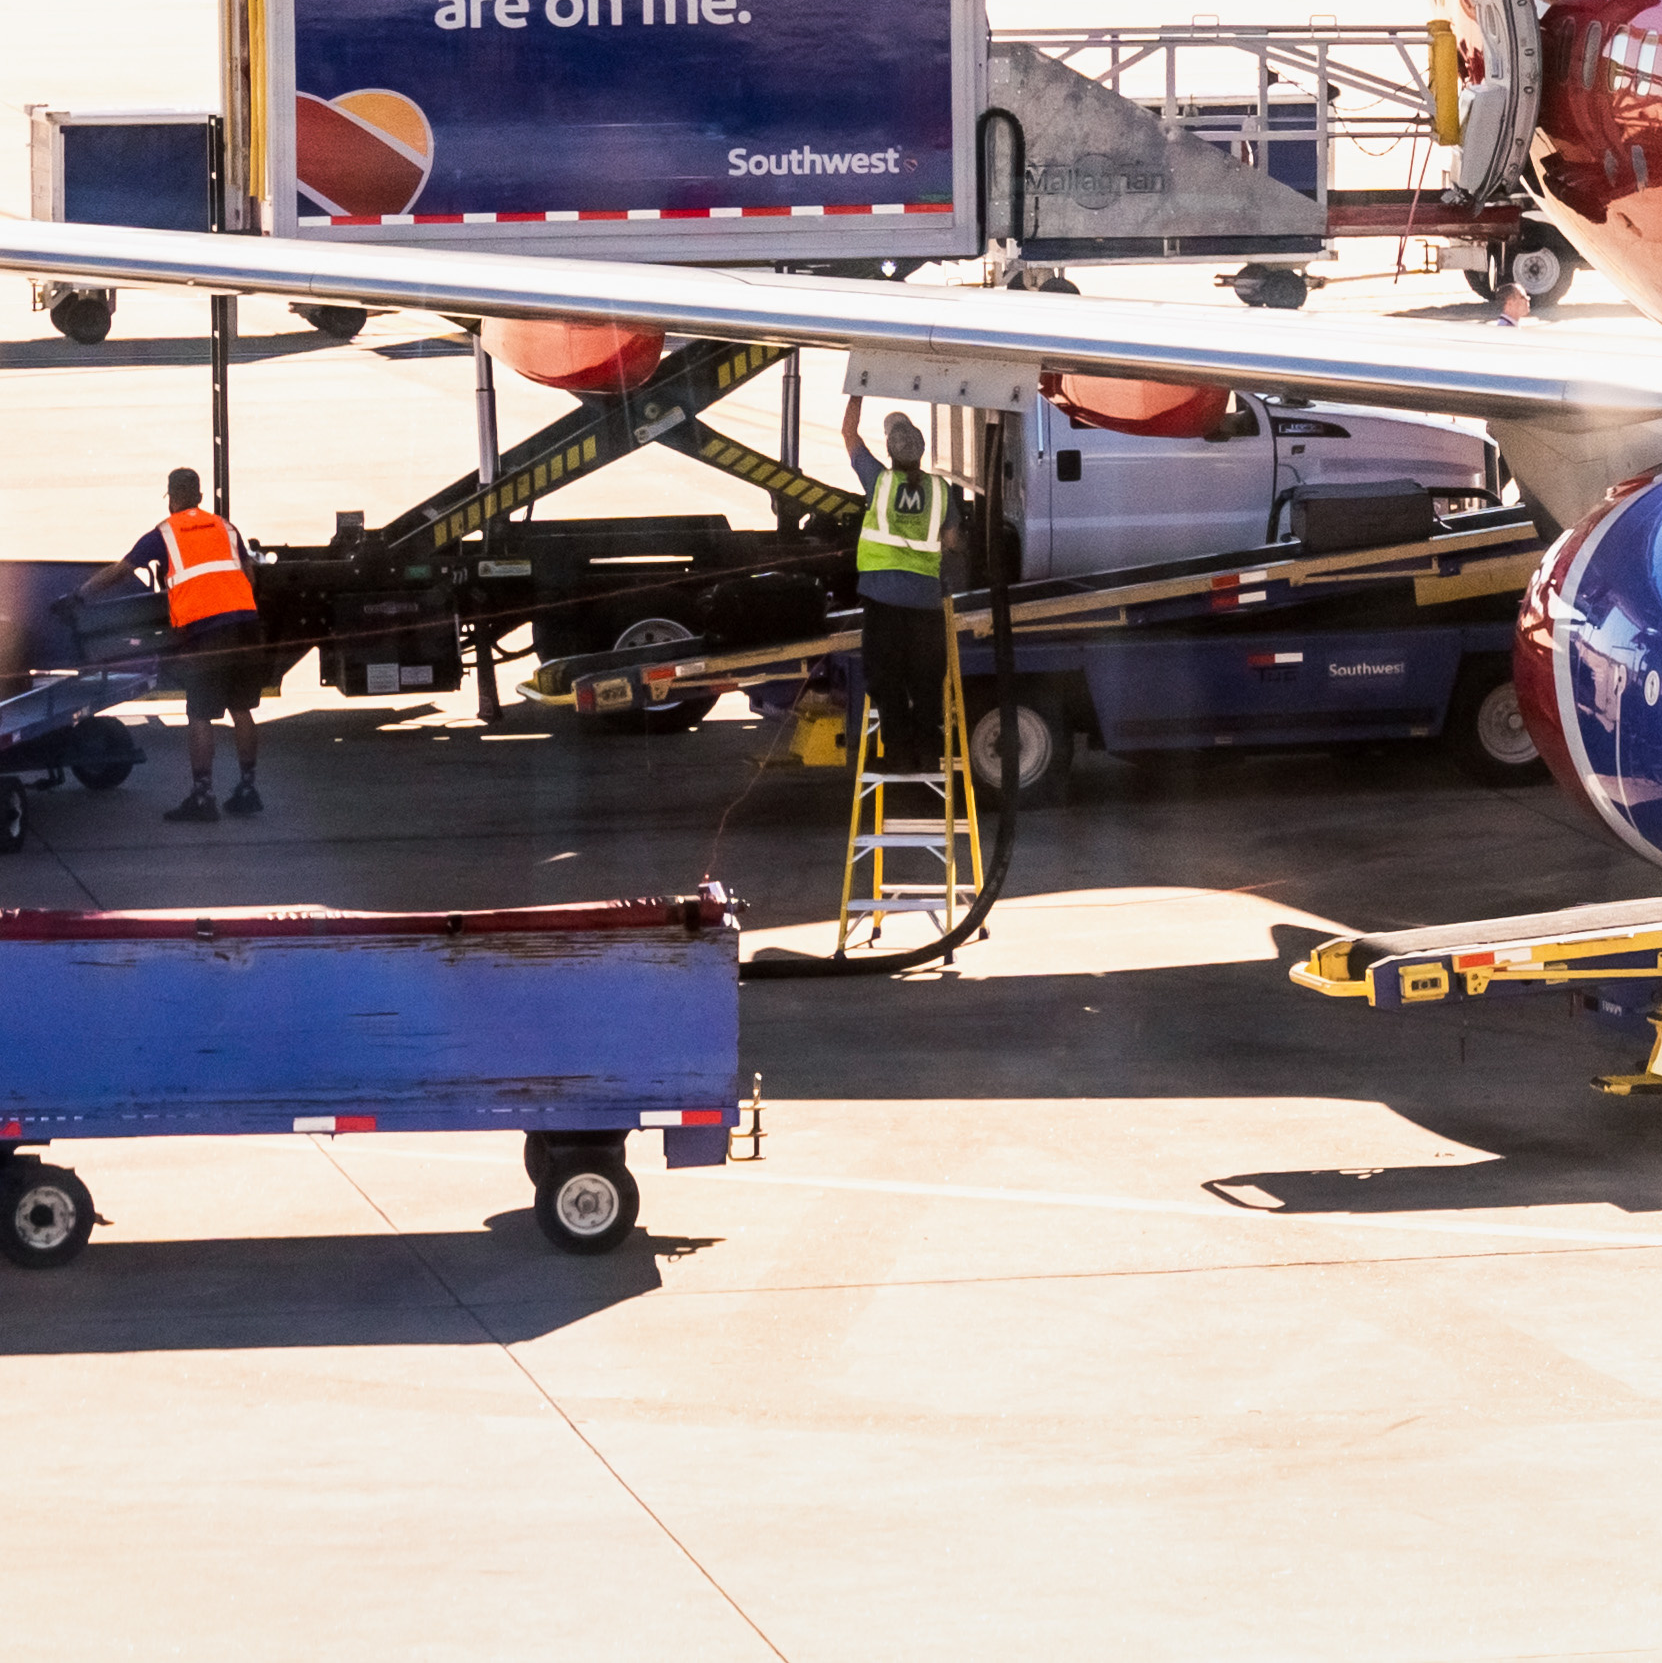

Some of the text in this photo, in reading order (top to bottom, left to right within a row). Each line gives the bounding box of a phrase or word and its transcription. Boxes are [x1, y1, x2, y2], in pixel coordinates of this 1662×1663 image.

[728, 145, 900, 176] Southwest
[898, 488, 922, 510] M
[1329, 662, 1405, 677] Southwest
